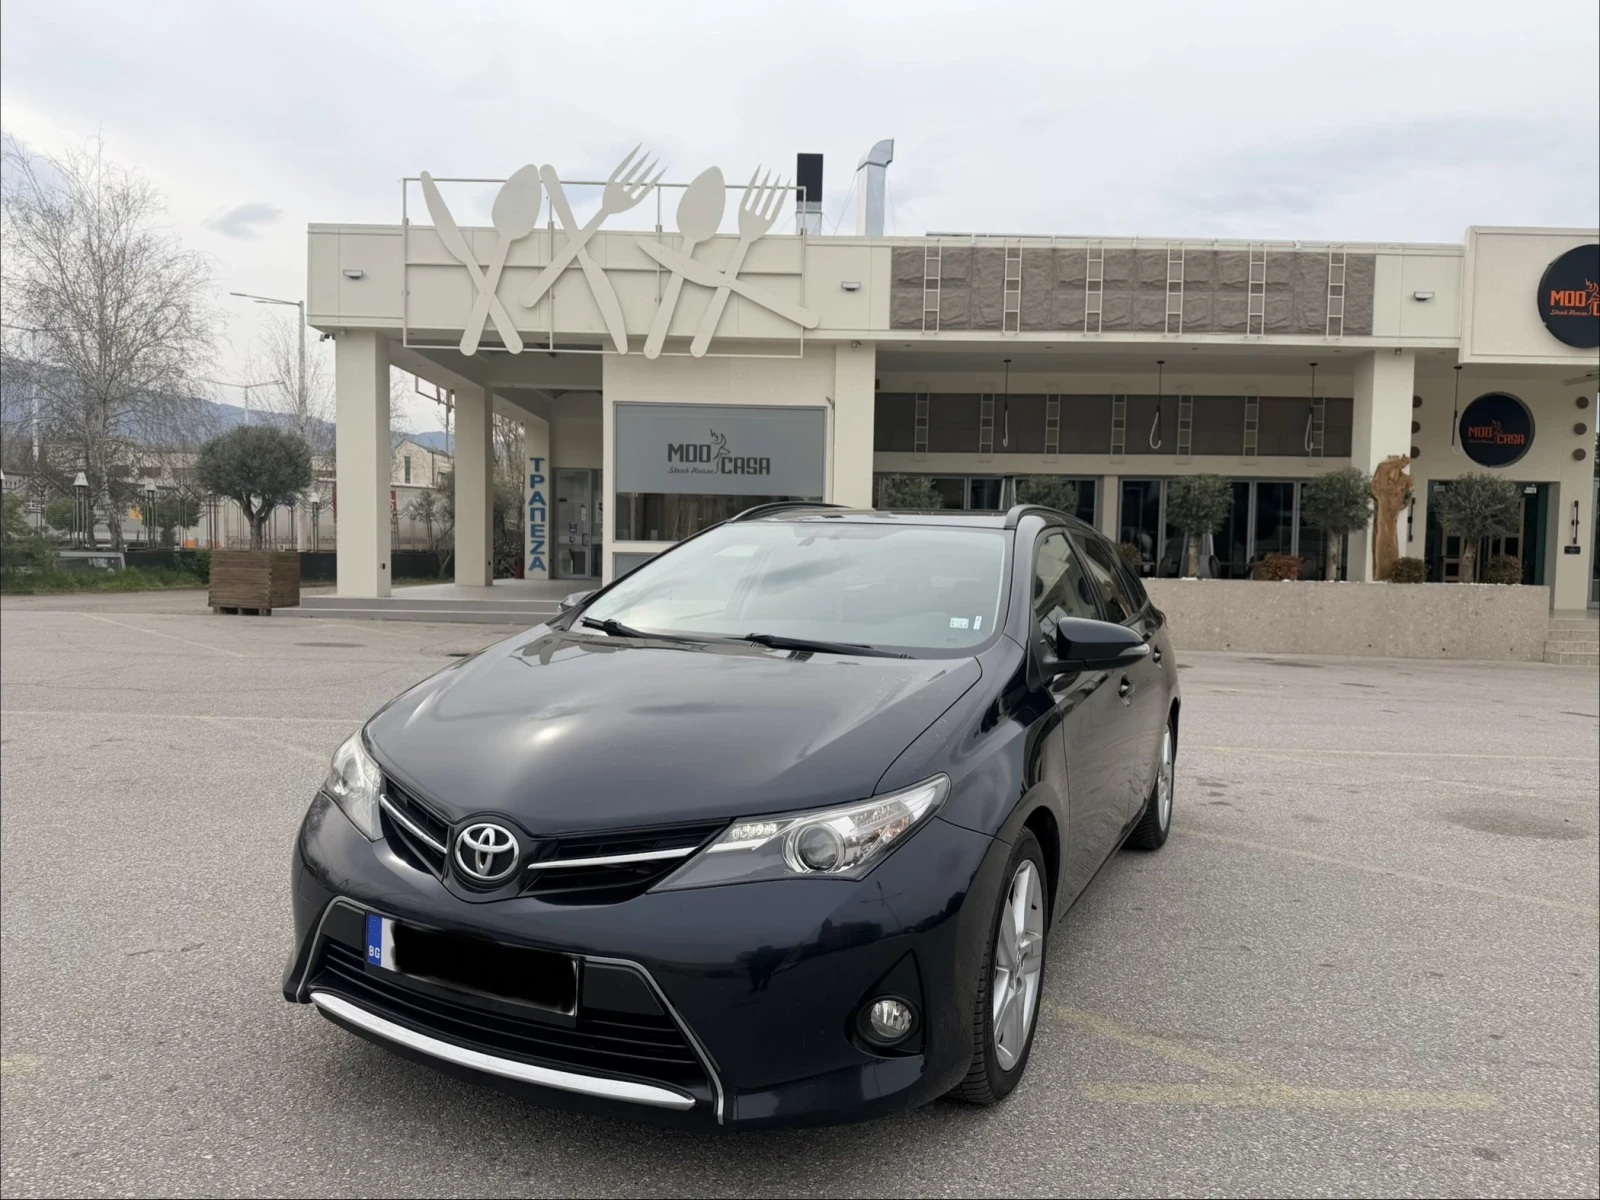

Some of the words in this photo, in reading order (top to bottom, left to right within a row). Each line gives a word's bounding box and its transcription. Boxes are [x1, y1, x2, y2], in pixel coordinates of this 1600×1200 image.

[1550, 290, 1587, 307] MOO
[1468, 426, 1492, 438] MOO
[1496, 433, 1525, 445] CASA
[667, 443, 712, 463] MOO
[721, 456, 771, 475] CASA
[667, 466, 689, 474] Steak
[690, 467, 714, 475] House
[368, 945, 381, 959] BG
